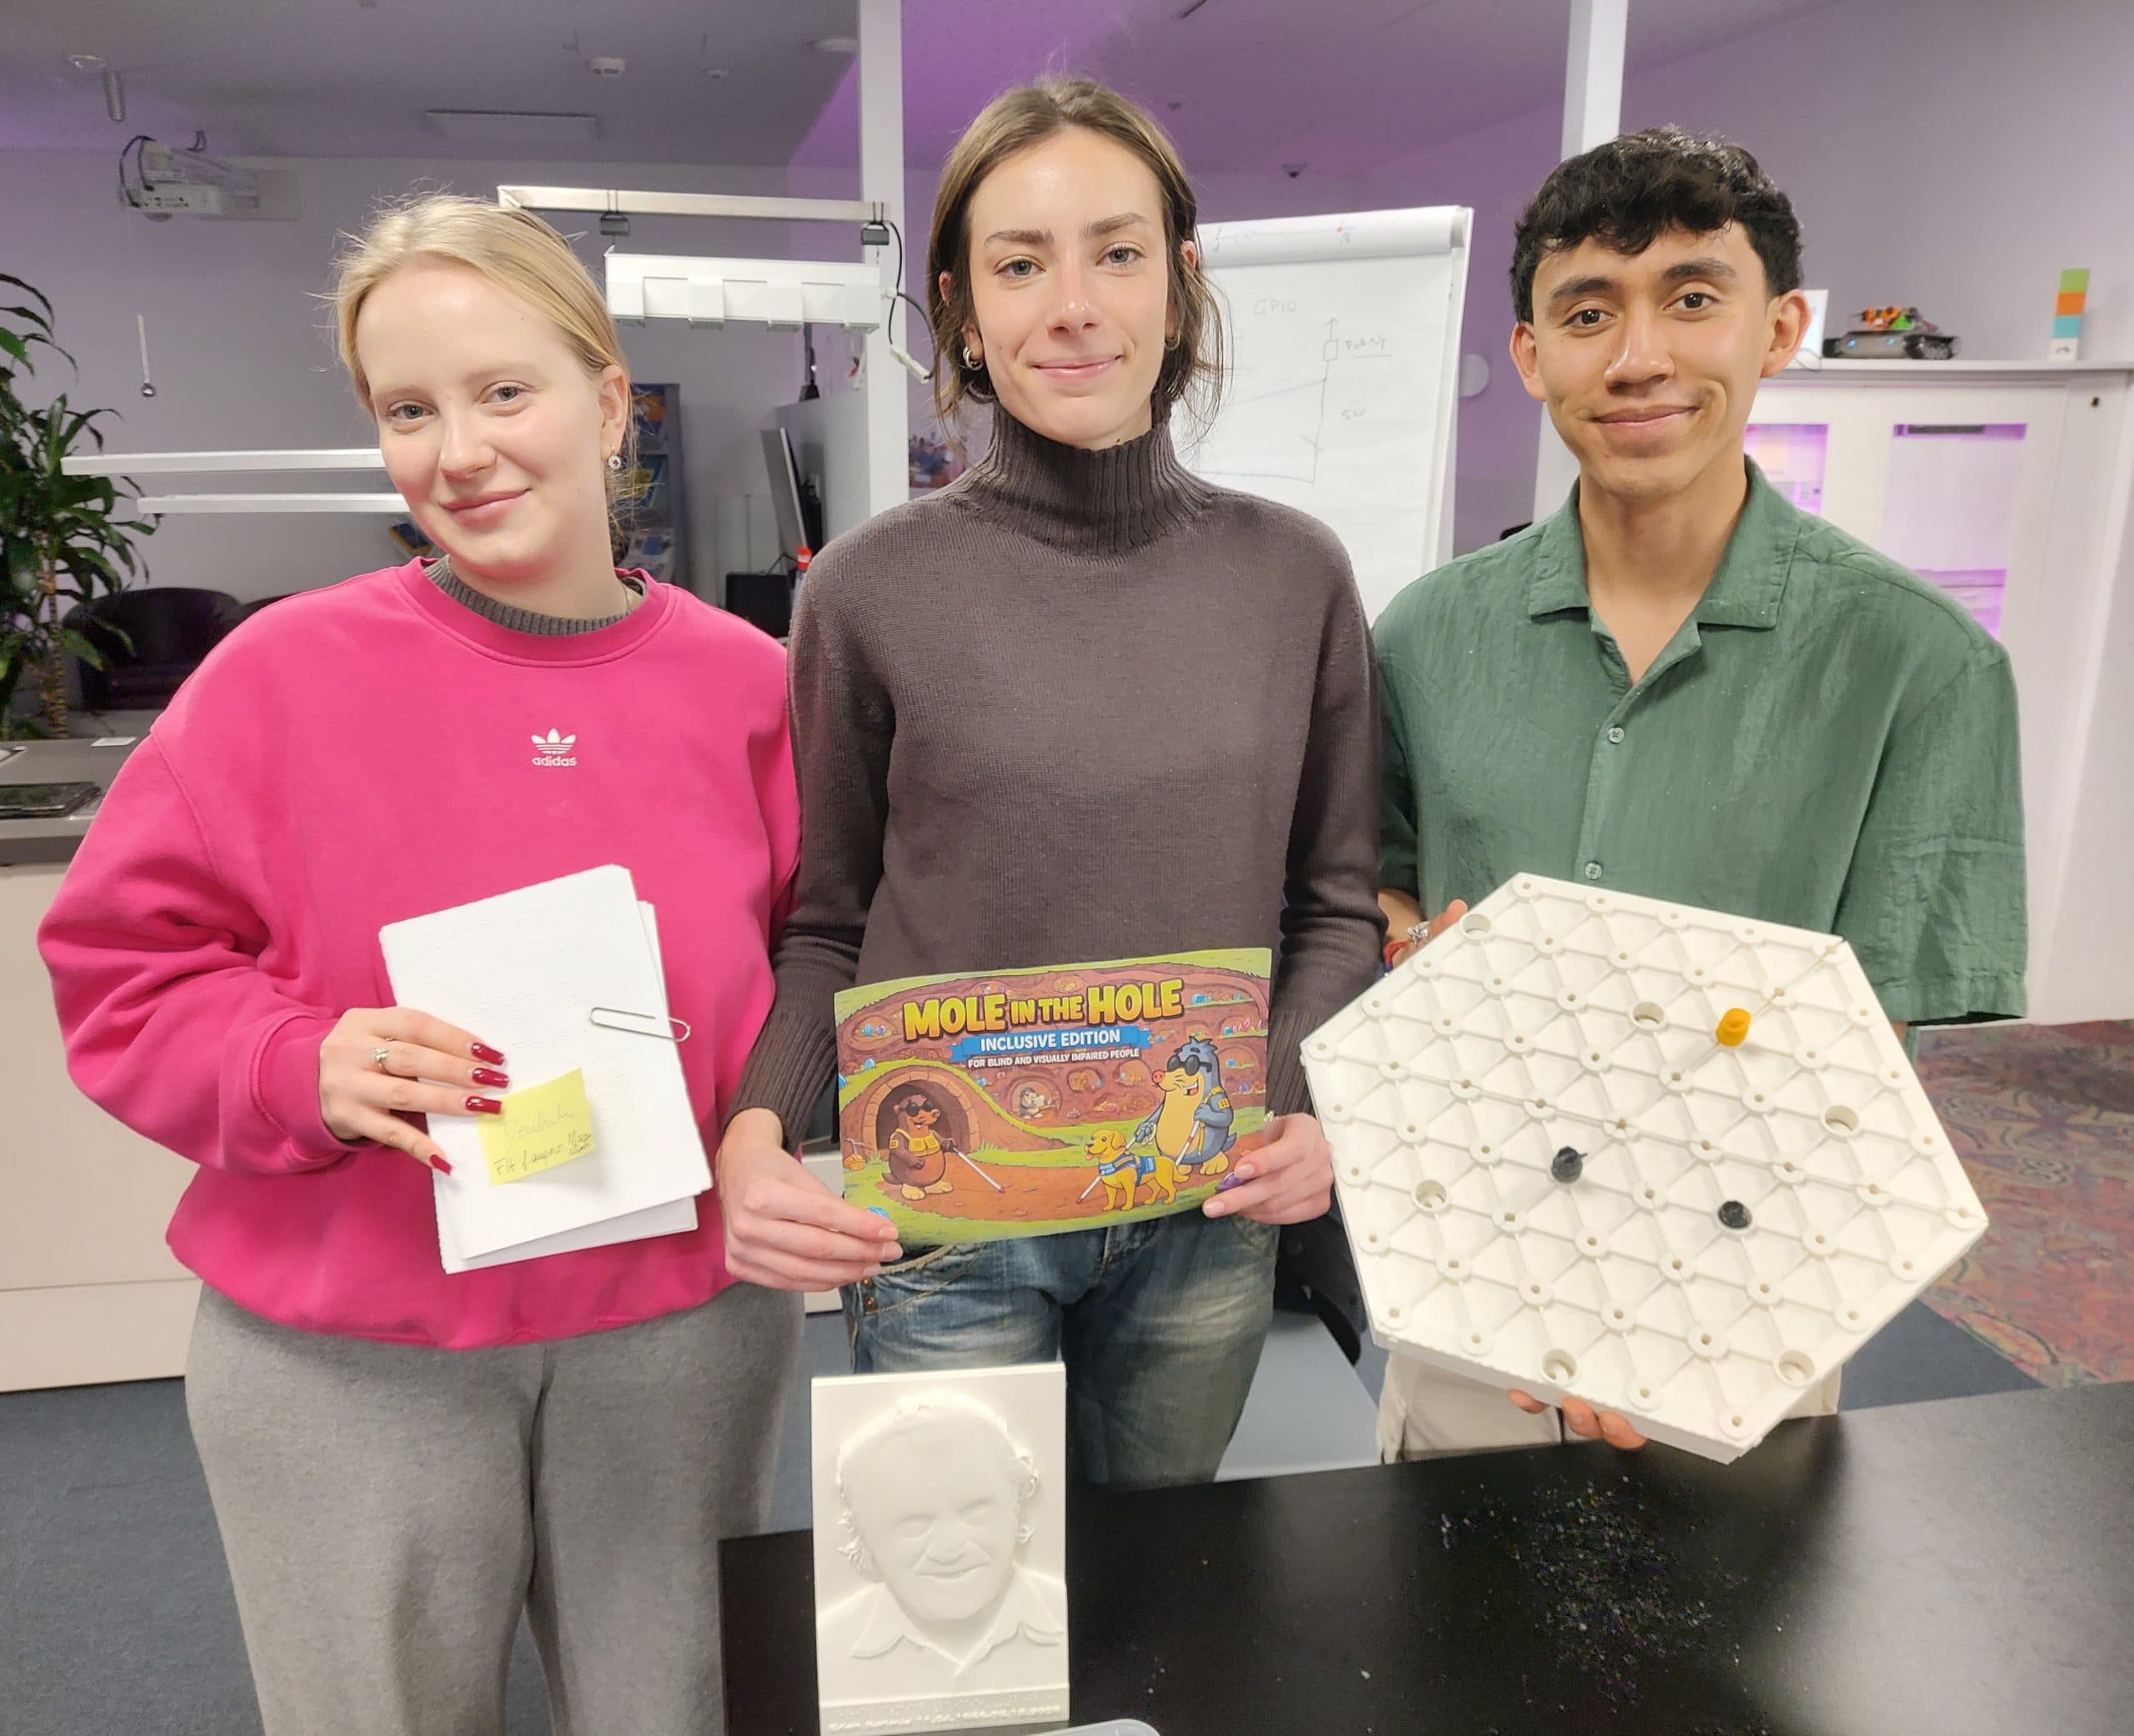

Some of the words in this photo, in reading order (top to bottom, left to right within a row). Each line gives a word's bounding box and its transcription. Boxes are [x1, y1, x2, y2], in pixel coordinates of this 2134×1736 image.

[532, 755, 577, 767] adidas
[903, 993, 1008, 1042] MOLE
[1010, 999, 1036, 1025] IN
[1039, 995, 1084, 1023] THE
[1087, 978, 1183, 1025] HOLE
[980, 1033, 1057, 1052] INCLUSIVE
[1060, 1028, 1120, 1047] EDITION
[968, 1058, 985, 1068] FOR
[987, 1057, 1012, 1067] BLIND
[1014, 1055, 1032, 1066] AND
[1033, 1053, 1070, 1064] VISUALLY
[1071, 1049, 1109, 1062] IMPAIRED
[1110, 1048, 1140, 1059] PEOPLE
